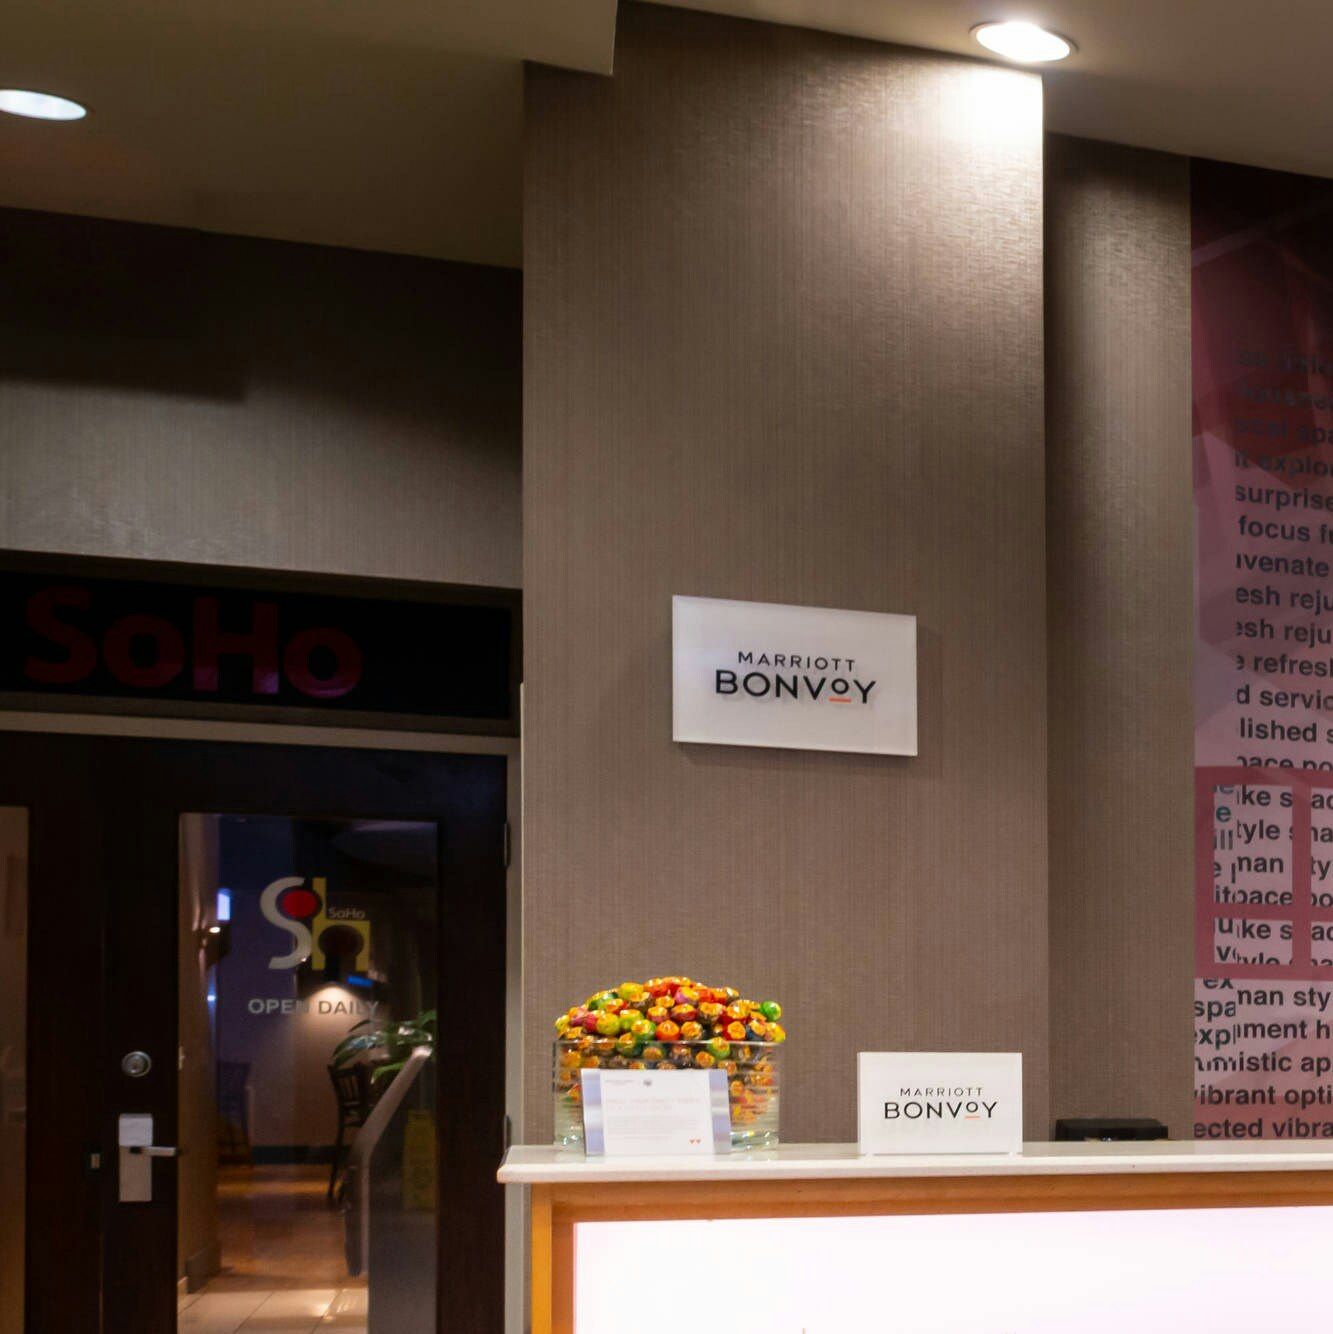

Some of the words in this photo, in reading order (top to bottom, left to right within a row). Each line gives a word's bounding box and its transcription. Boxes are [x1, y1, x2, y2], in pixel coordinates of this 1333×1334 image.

[1238, 515, 1311, 543] focus
[24, 584, 363, 698] SoHo
[738, 651, 855, 672] MARRIOTT
[715, 669, 876, 704] BONVOY
[1240, 717, 1317, 744] lished
[329, 907, 366, 920] SoHo
[247, 999, 311, 1014] OPEN
[318, 1001, 380, 1015] DAILY
[900, 1087, 983, 1097] MARRIOTT
[884, 1101, 998, 1119] BONVOY
